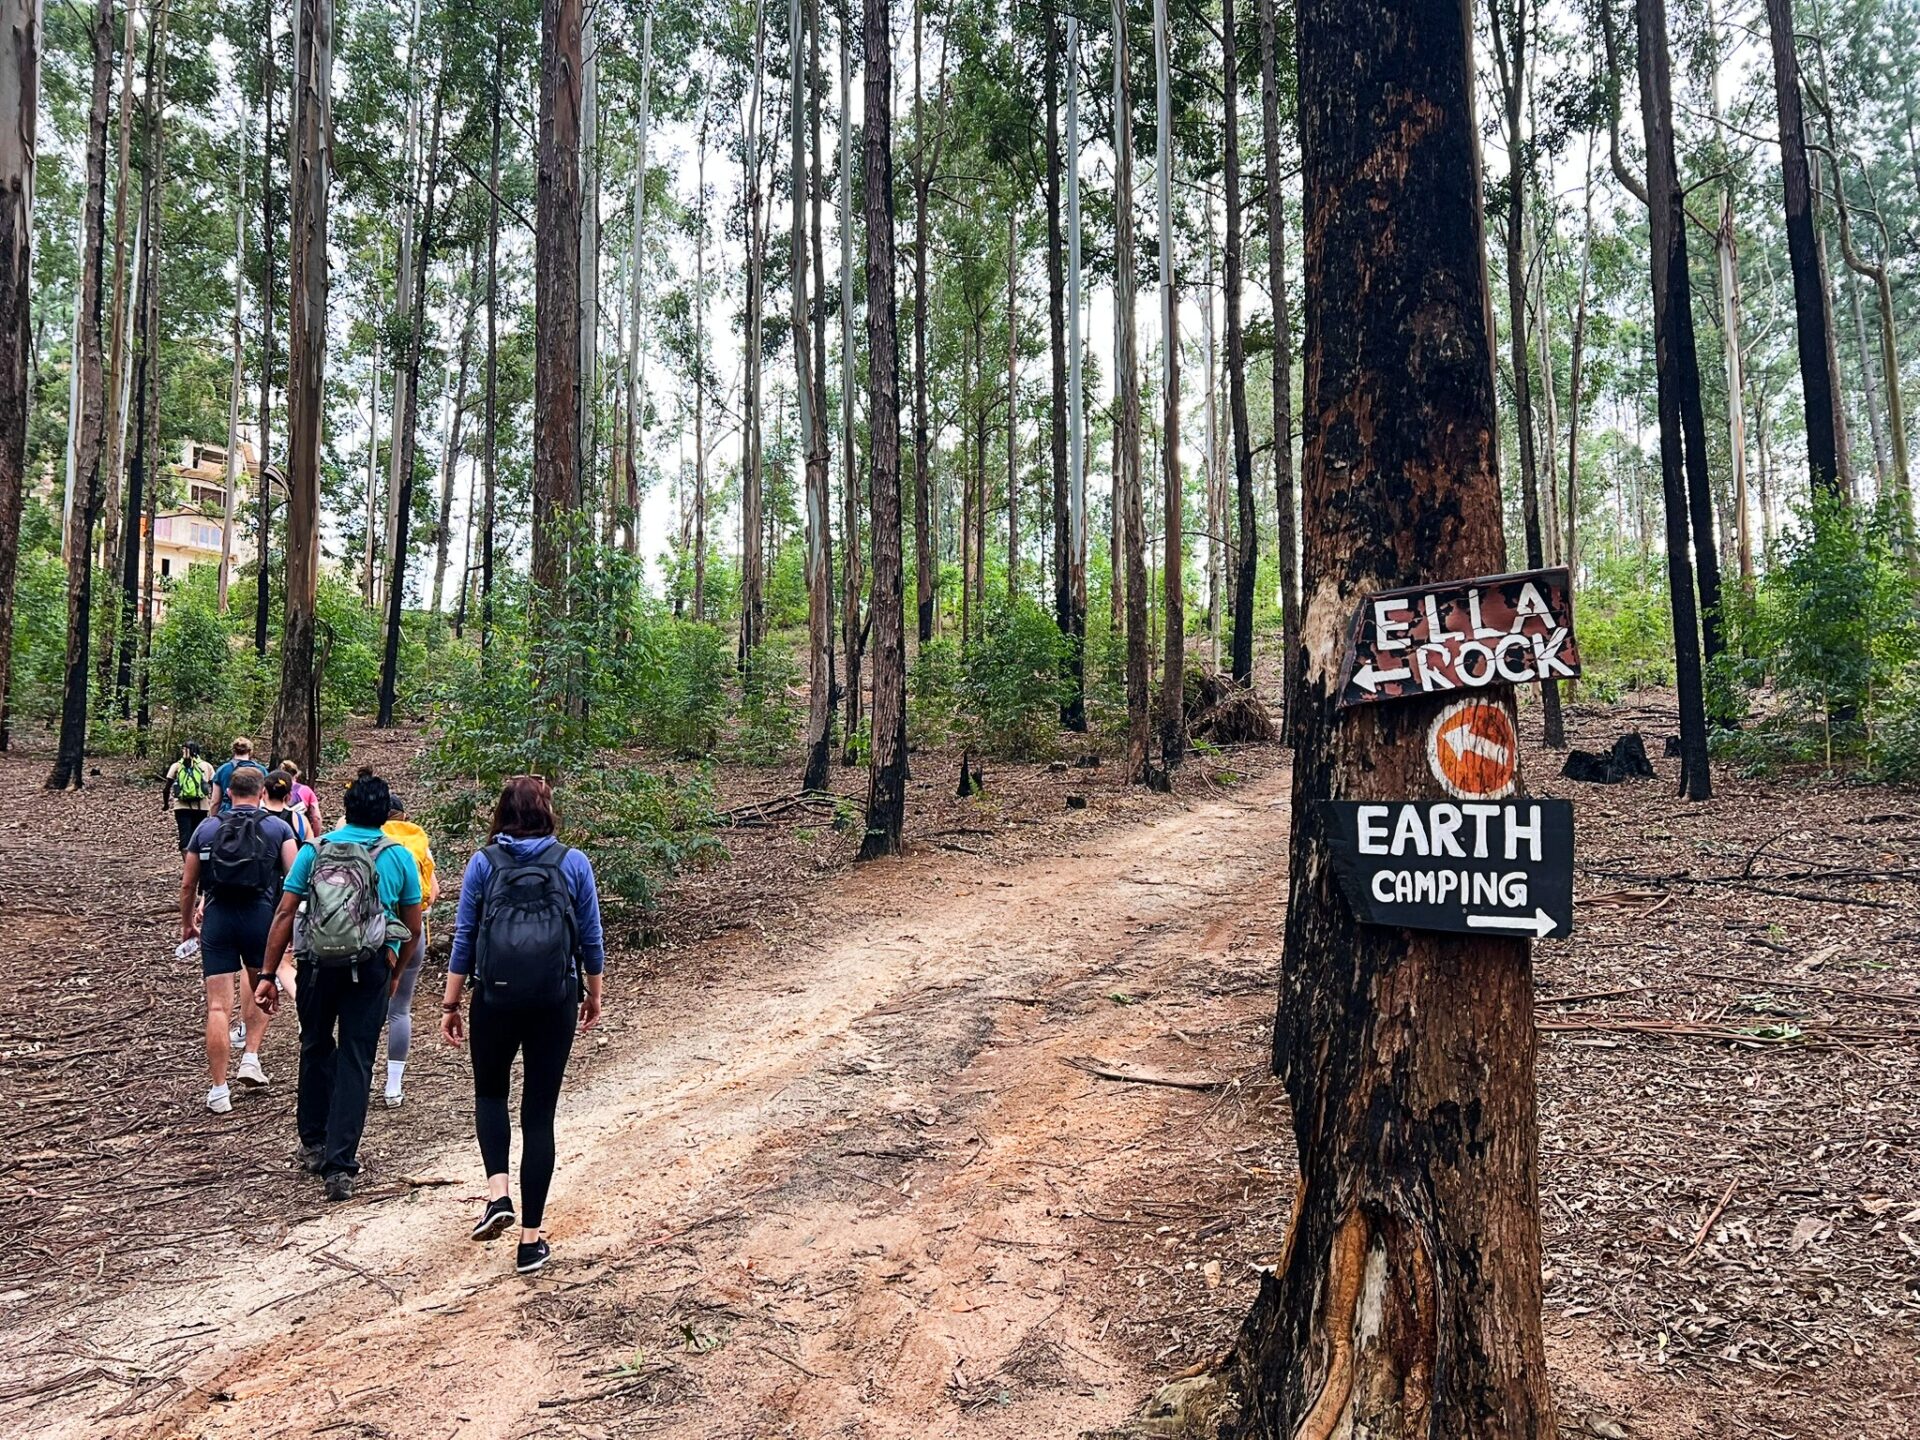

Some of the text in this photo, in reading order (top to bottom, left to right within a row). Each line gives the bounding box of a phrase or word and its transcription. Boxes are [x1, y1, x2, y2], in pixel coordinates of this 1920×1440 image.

[1374, 582, 1556, 650] ELLA
[1416, 627, 1575, 691] ROCK
[1357, 804, 1542, 861] EARTH
[1372, 870, 1528, 907] CAMPING
